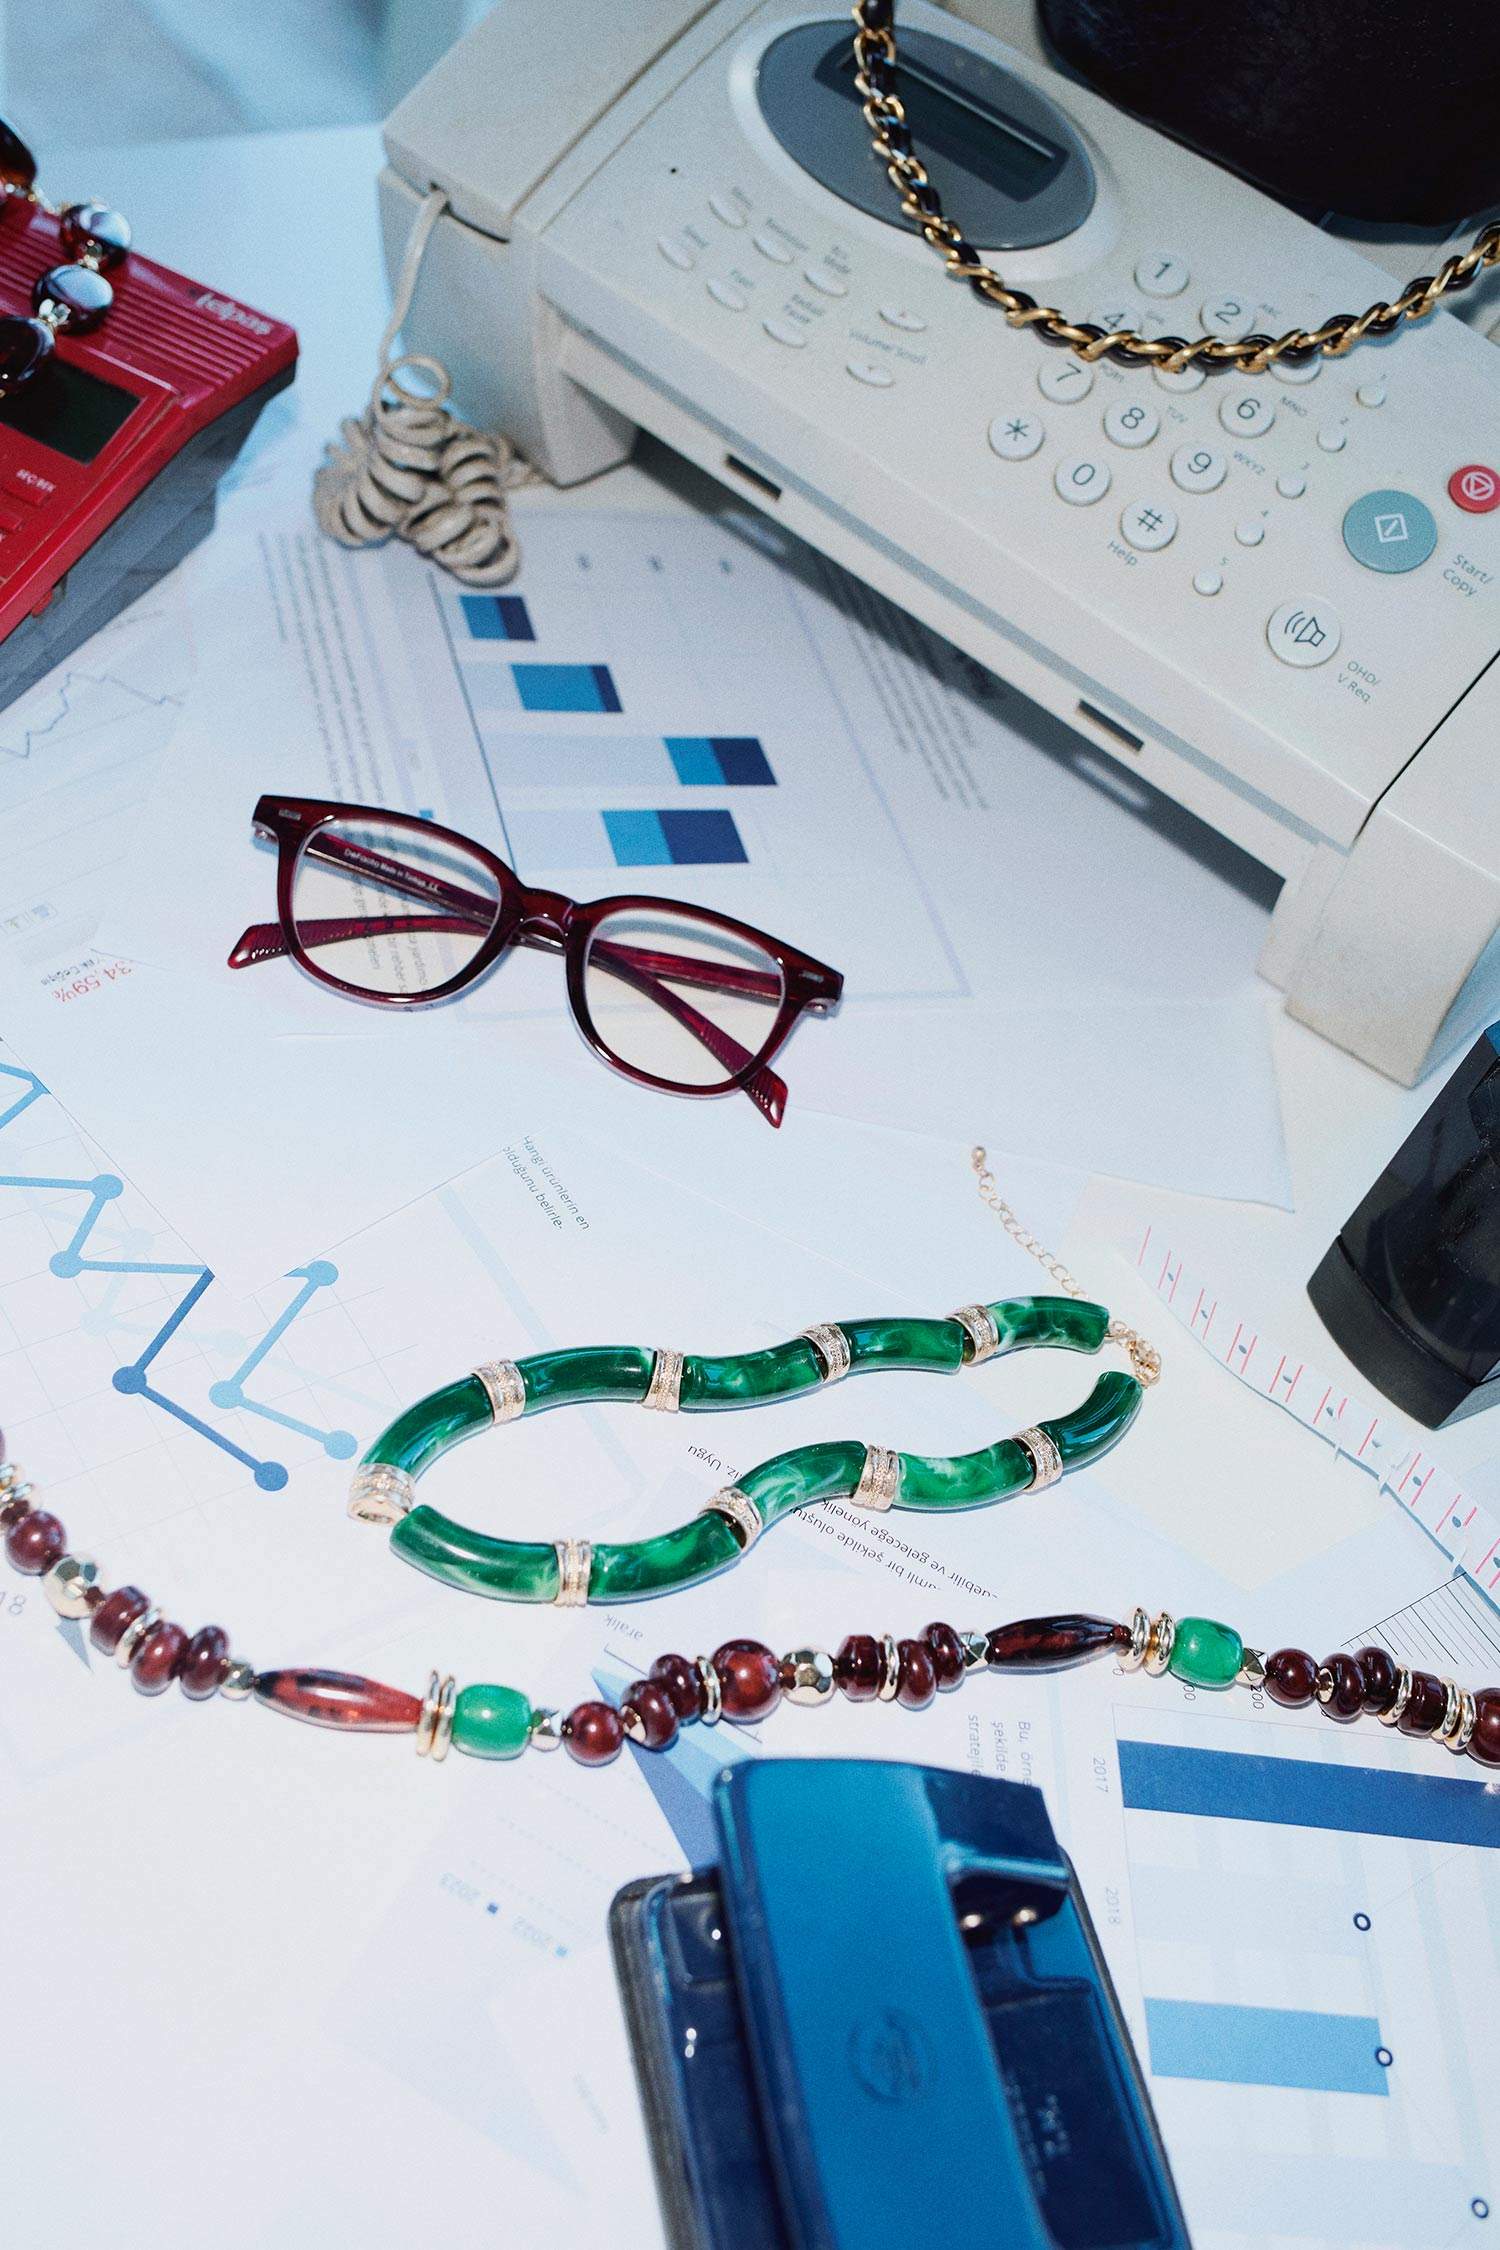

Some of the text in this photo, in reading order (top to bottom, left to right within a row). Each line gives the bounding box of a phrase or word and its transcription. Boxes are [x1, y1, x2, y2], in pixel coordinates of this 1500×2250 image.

[1156, 262, 1172, 278] 1
[1104, 314, 1124, 329] 4
[1216, 303, 1240, 324] 2
[1057, 363, 1081, 381] 7
[1121, 407, 1145, 429] 8
[1237, 399, 1260, 420] 6
[1188, 452, 1212, 474] 9
[1073, 464, 1095, 485] 0
[1137, 509, 1163, 531] #
[1108, 541, 1138, 566] Help
[1453, 554, 1494, 585] Start/
[1443, 569, 1477, 597] Copy
[576, 1215, 590, 1230] en
[822, 1497, 870, 1531] yönelik
[837, 1531, 884, 1563] şekilde
[871, 1524, 929, 1566] geleceğe
[887, 1560, 904, 1577] bir
[930, 1560, 946, 1575] ve
[991, 1721, 1007, 1773] şekilde
[1094, 1756, 1109, 1793] 2017
[1105, 1886, 1121, 1925] 2018
